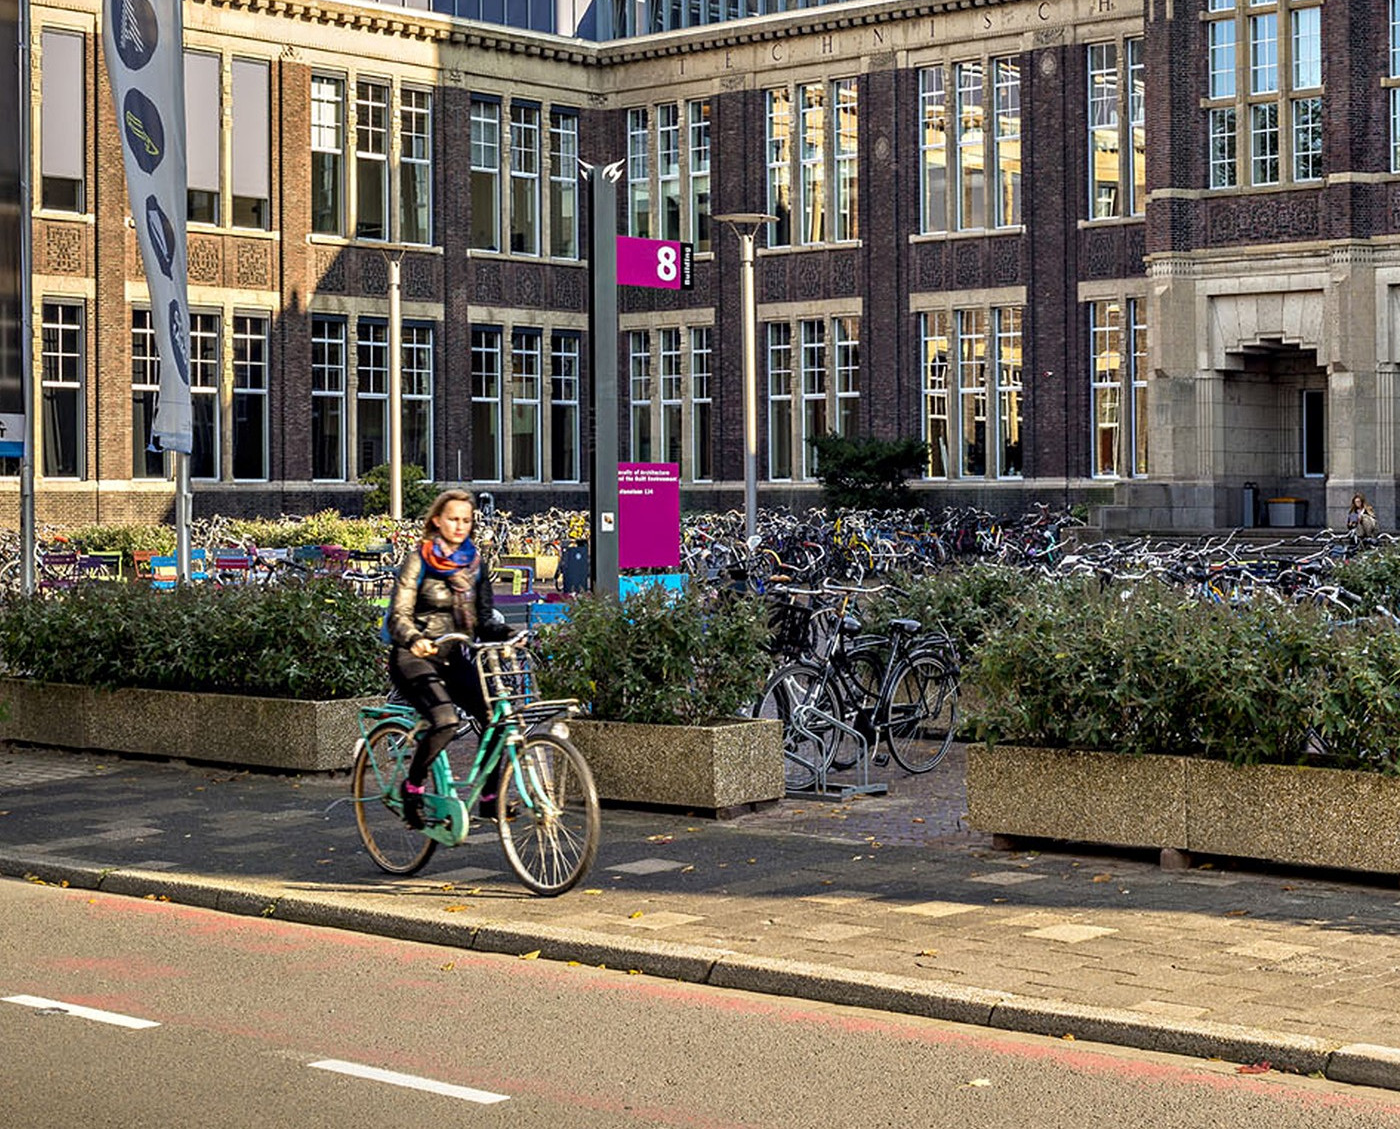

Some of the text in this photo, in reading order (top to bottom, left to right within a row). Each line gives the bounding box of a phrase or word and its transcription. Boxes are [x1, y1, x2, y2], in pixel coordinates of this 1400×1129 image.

[657, 246, 677, 282] 8
[684, 247, 692, 286] Building
[618, 469, 633, 477] aculty
